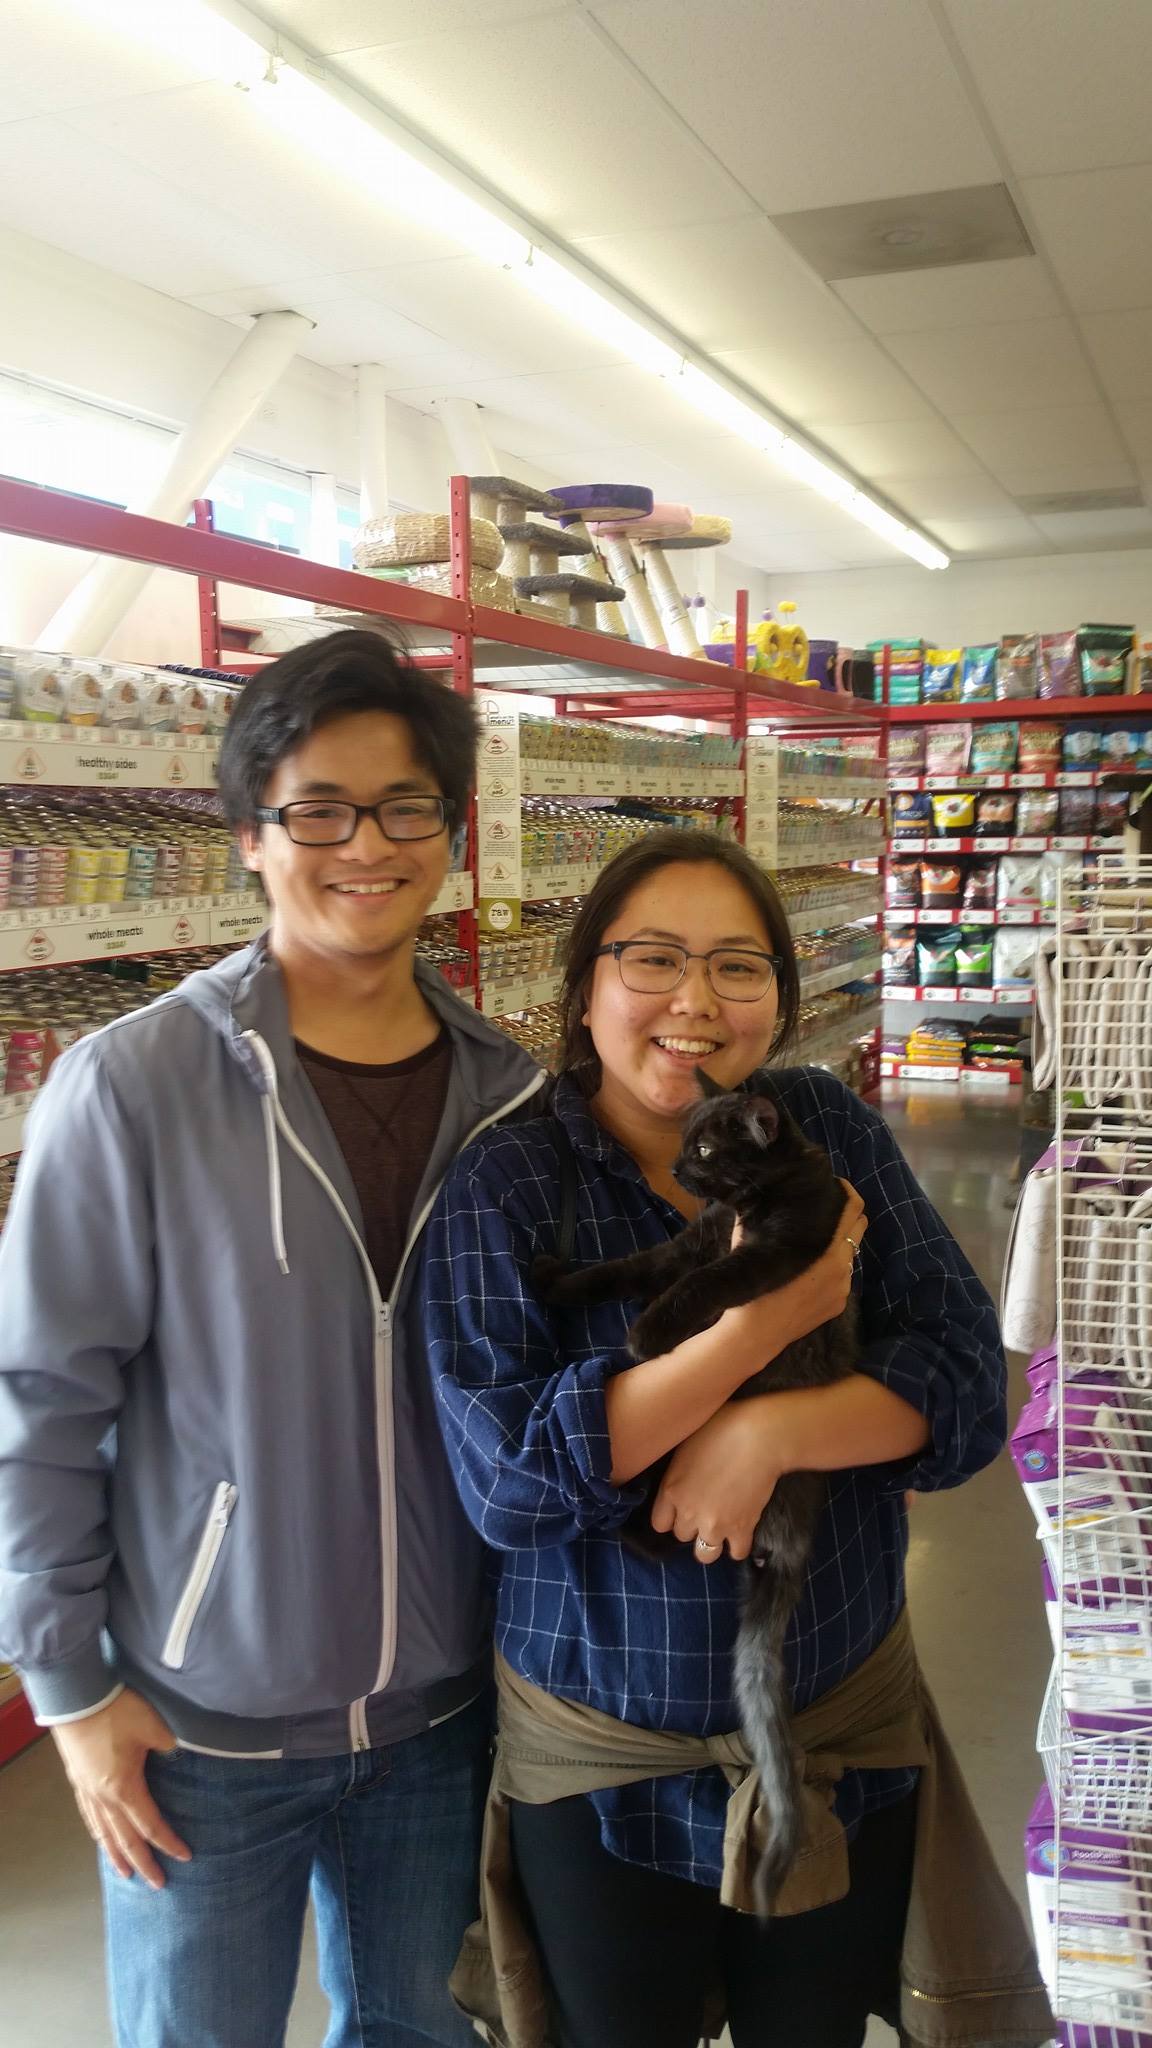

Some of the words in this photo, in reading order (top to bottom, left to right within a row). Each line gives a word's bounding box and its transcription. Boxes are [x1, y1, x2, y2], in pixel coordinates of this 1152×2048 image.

[78, 756, 112, 771] healthy
[114, 757, 137, 769] sides
[491, 909, 509, 917] raw
[219, 918, 241, 928] whole
[241, 916, 263, 925] meats
[88, 928, 114, 941] whole
[116, 926, 144, 937] meats
